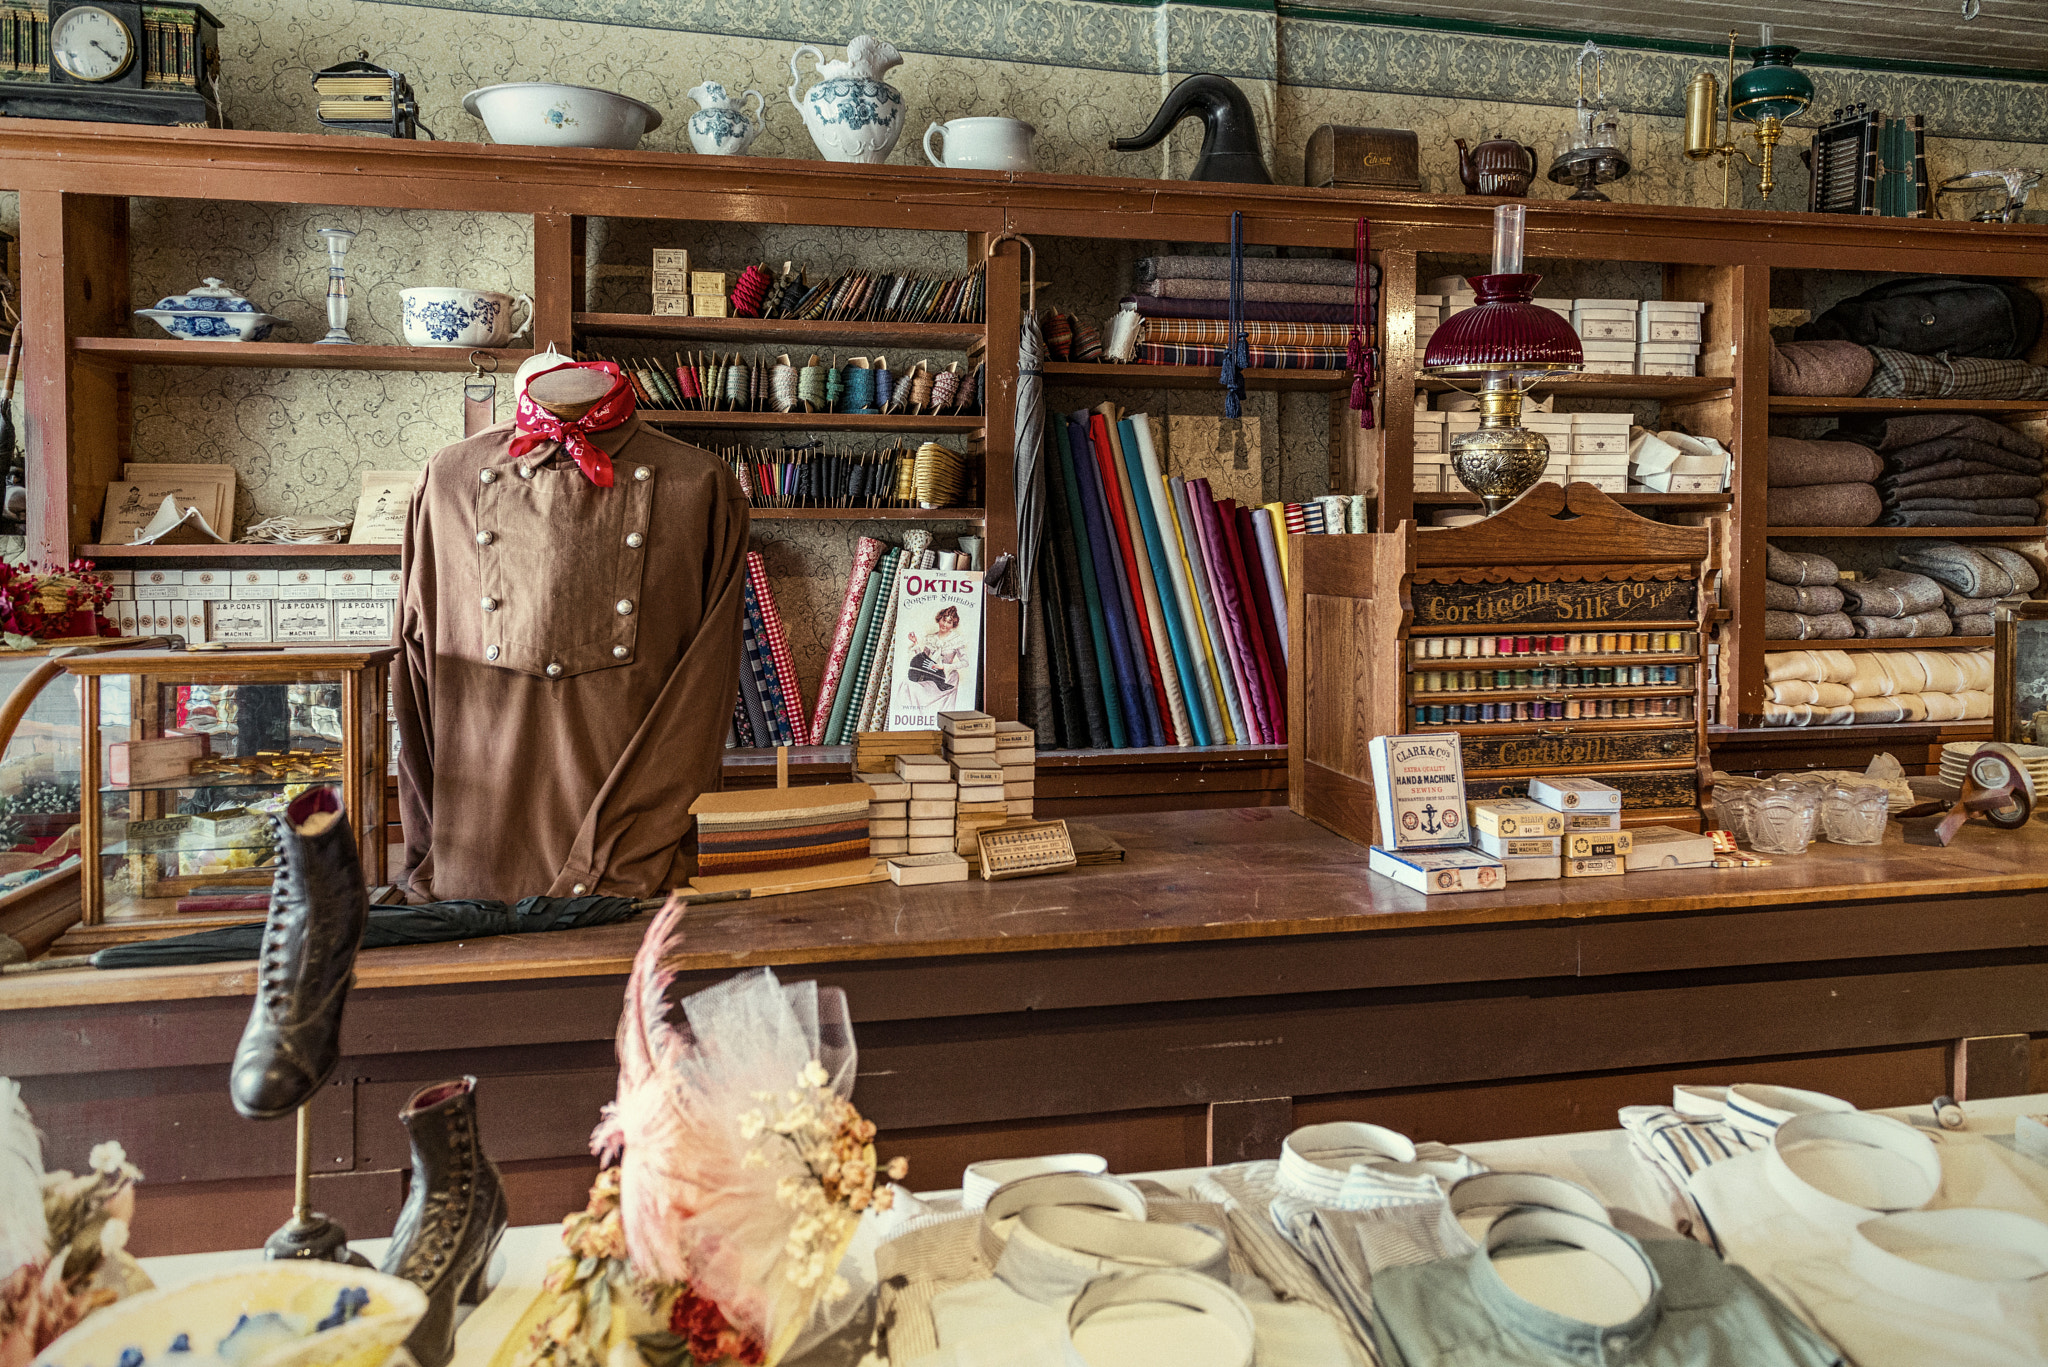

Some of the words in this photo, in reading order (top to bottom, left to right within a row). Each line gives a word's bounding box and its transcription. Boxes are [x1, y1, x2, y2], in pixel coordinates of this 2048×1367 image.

[666, 256, 674, 264] A
[668, 302, 674, 310] A
[1430, 583, 1551, 622] Corticelli
[1556, 594, 1610, 621] Silk
[1617, 582, 1650, 608] Co.
[894, 714, 935, 726] DOUBLE
[1396, 745, 1427, 763] CLARK
[1427, 745, 1435, 756] &
[1499, 739, 1610, 766] Corticelli
[1396, 775, 1416, 785] HAND
[1417, 775, 1423, 784] &
[1423, 774, 1456, 783] MACHINE
[1411, 786, 1443, 794] SEWING
